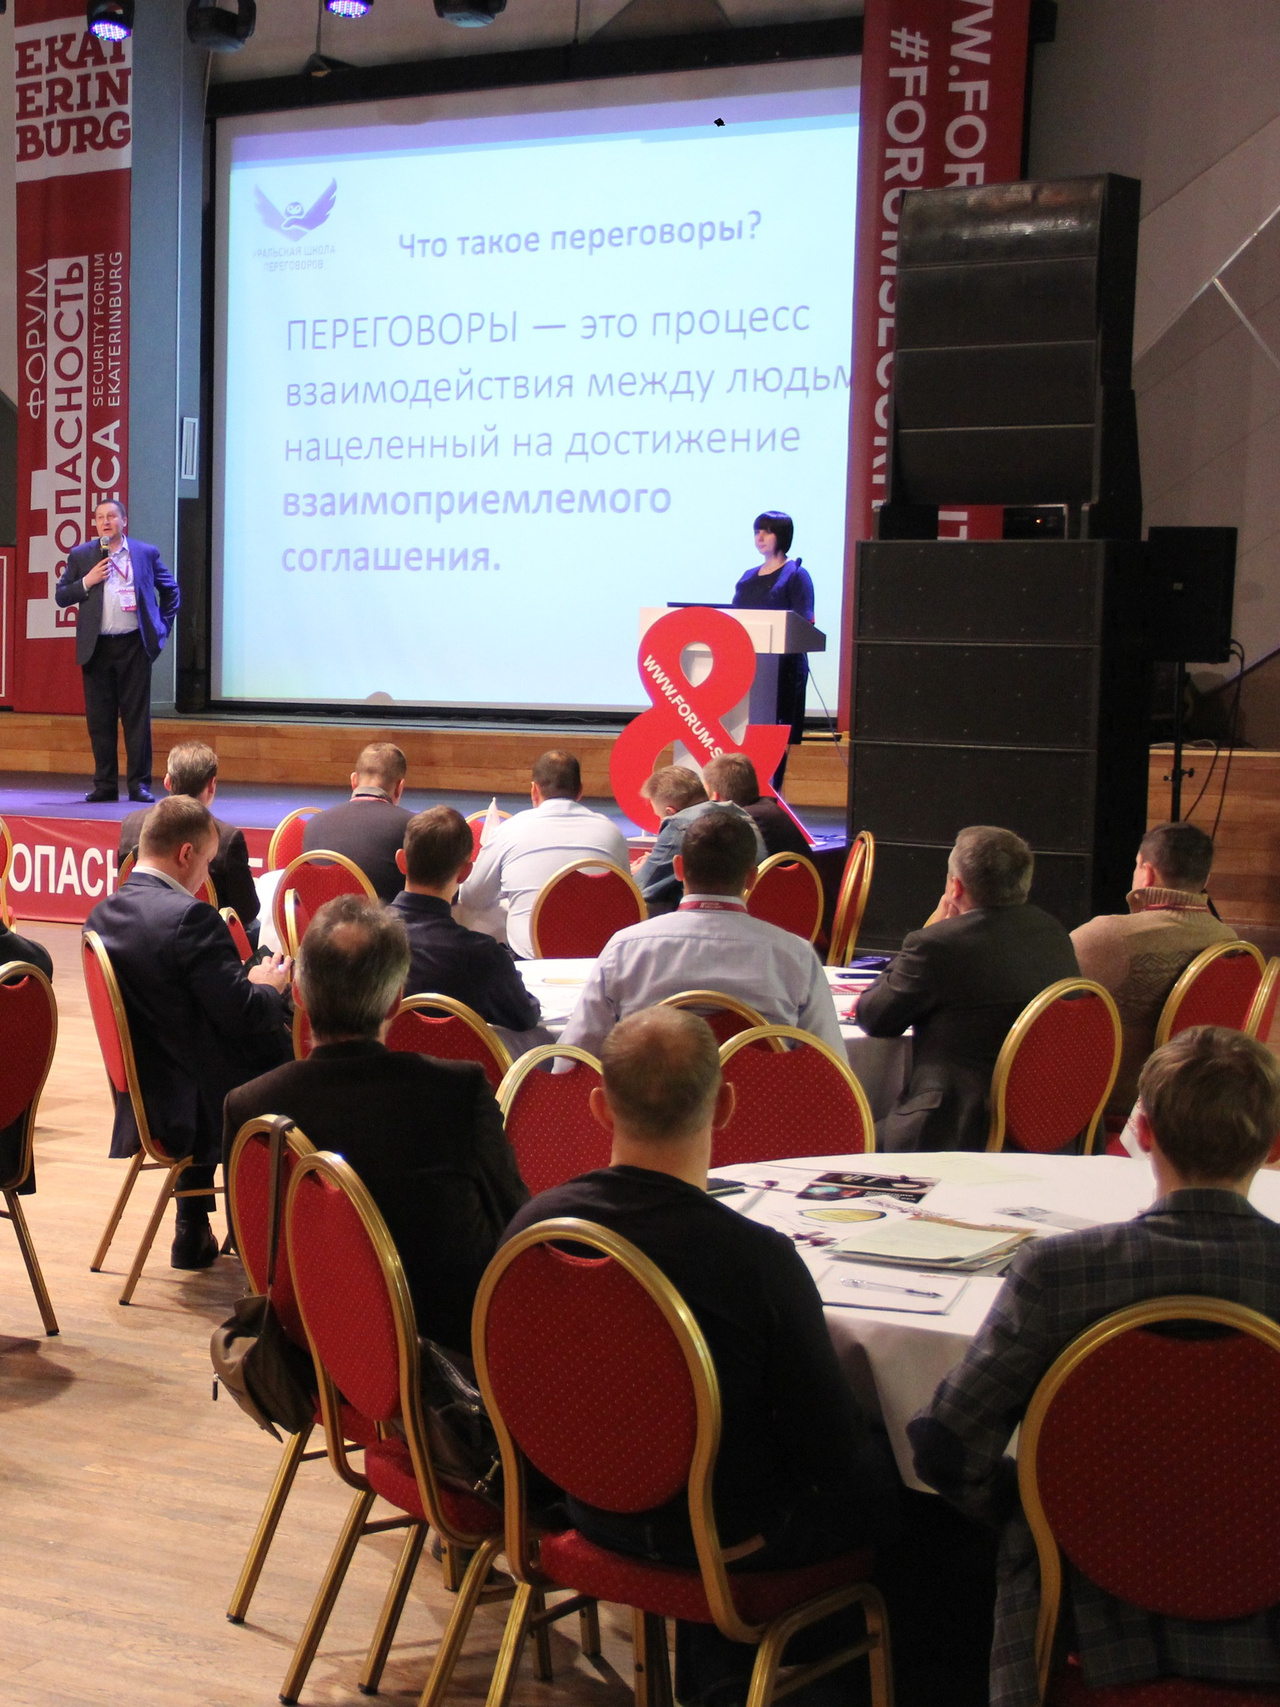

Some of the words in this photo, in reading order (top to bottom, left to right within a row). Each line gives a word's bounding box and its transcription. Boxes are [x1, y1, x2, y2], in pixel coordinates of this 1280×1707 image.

[16, 68, 131, 120] ERIN
[16, 111, 131, 162] BURG
[399, 233, 448, 259] Что
[457, 231, 540, 256] такое
[551, 210, 762, 252] переговоры?
[93, 253, 105, 315] FORUM
[25, 263, 47, 419] ФОРУМ
[108, 251, 123, 407] EKATERINBURG
[287, 310, 517, 352] ПЕРЕГОВОРЫ
[580, 313, 638, 340] это
[652, 304, 811, 344] процесс
[93, 322, 105, 407] SECURITY
[287, 367, 574, 410] взаимодействия
[587, 369, 716, 404] между
[54, 262, 84, 628] БОПАСНОСТЬ
[285, 423, 499, 467] нацеленный
[513, 432, 553, 458] на
[564, 426, 801, 463] достижение
[283, 482, 672, 524] взаимоприемлемого
[282, 545, 502, 574] соглашения.
